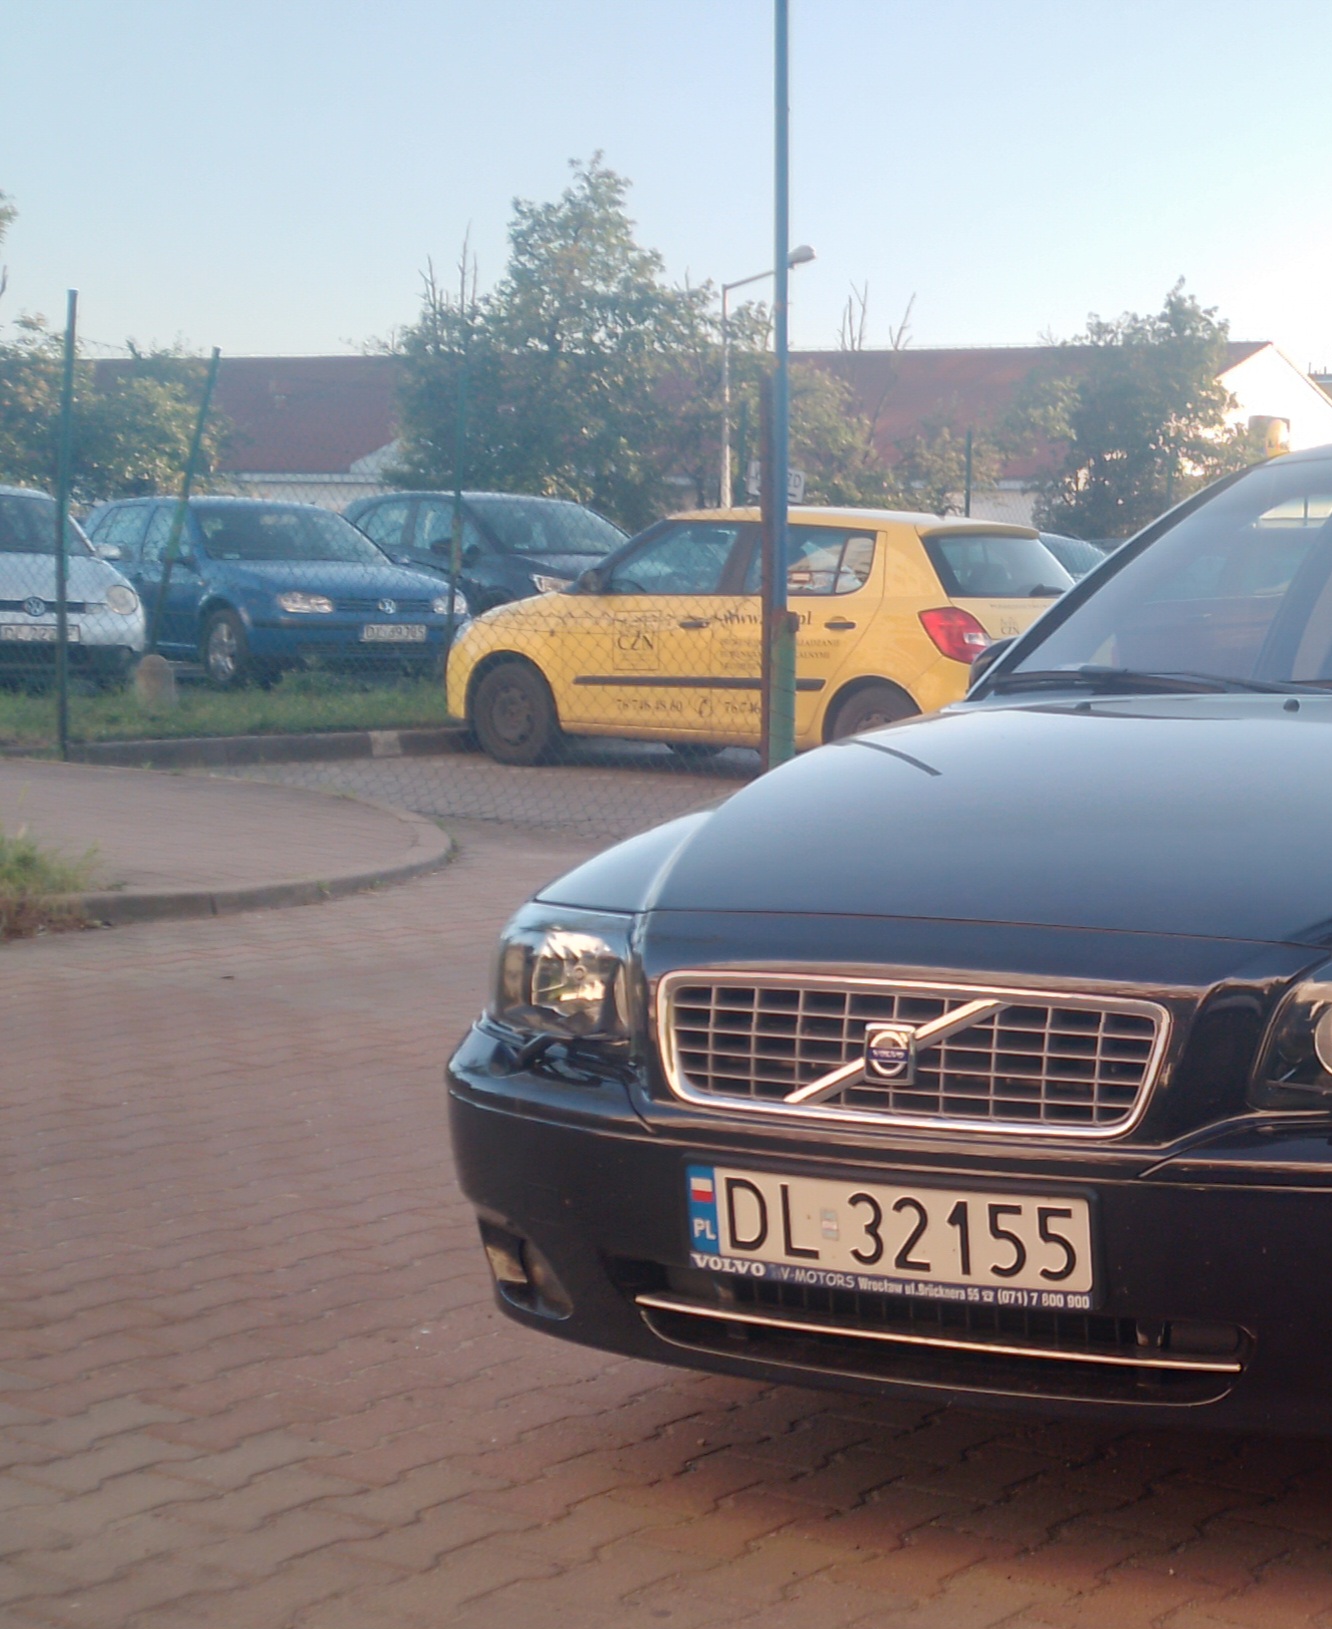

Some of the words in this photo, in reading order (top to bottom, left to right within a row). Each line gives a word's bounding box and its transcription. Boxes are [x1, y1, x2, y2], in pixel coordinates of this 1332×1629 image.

[872, 1049, 905, 1059] VOLVO
[692, 1217, 717, 1241] PL
[724, 1176, 820, 1261] DL
[847, 1192, 1078, 1282] 32155
[690, 1253, 767, 1277] VOLVO
[780, 1266, 856, 1289] V-MOTORS
[967, 1286, 980, 1301] 55
[997, 1288, 1028, 1307] (071)
[1030, 1292, 1039, 1306] 7
[1067, 1294, 1091, 1309] 900
